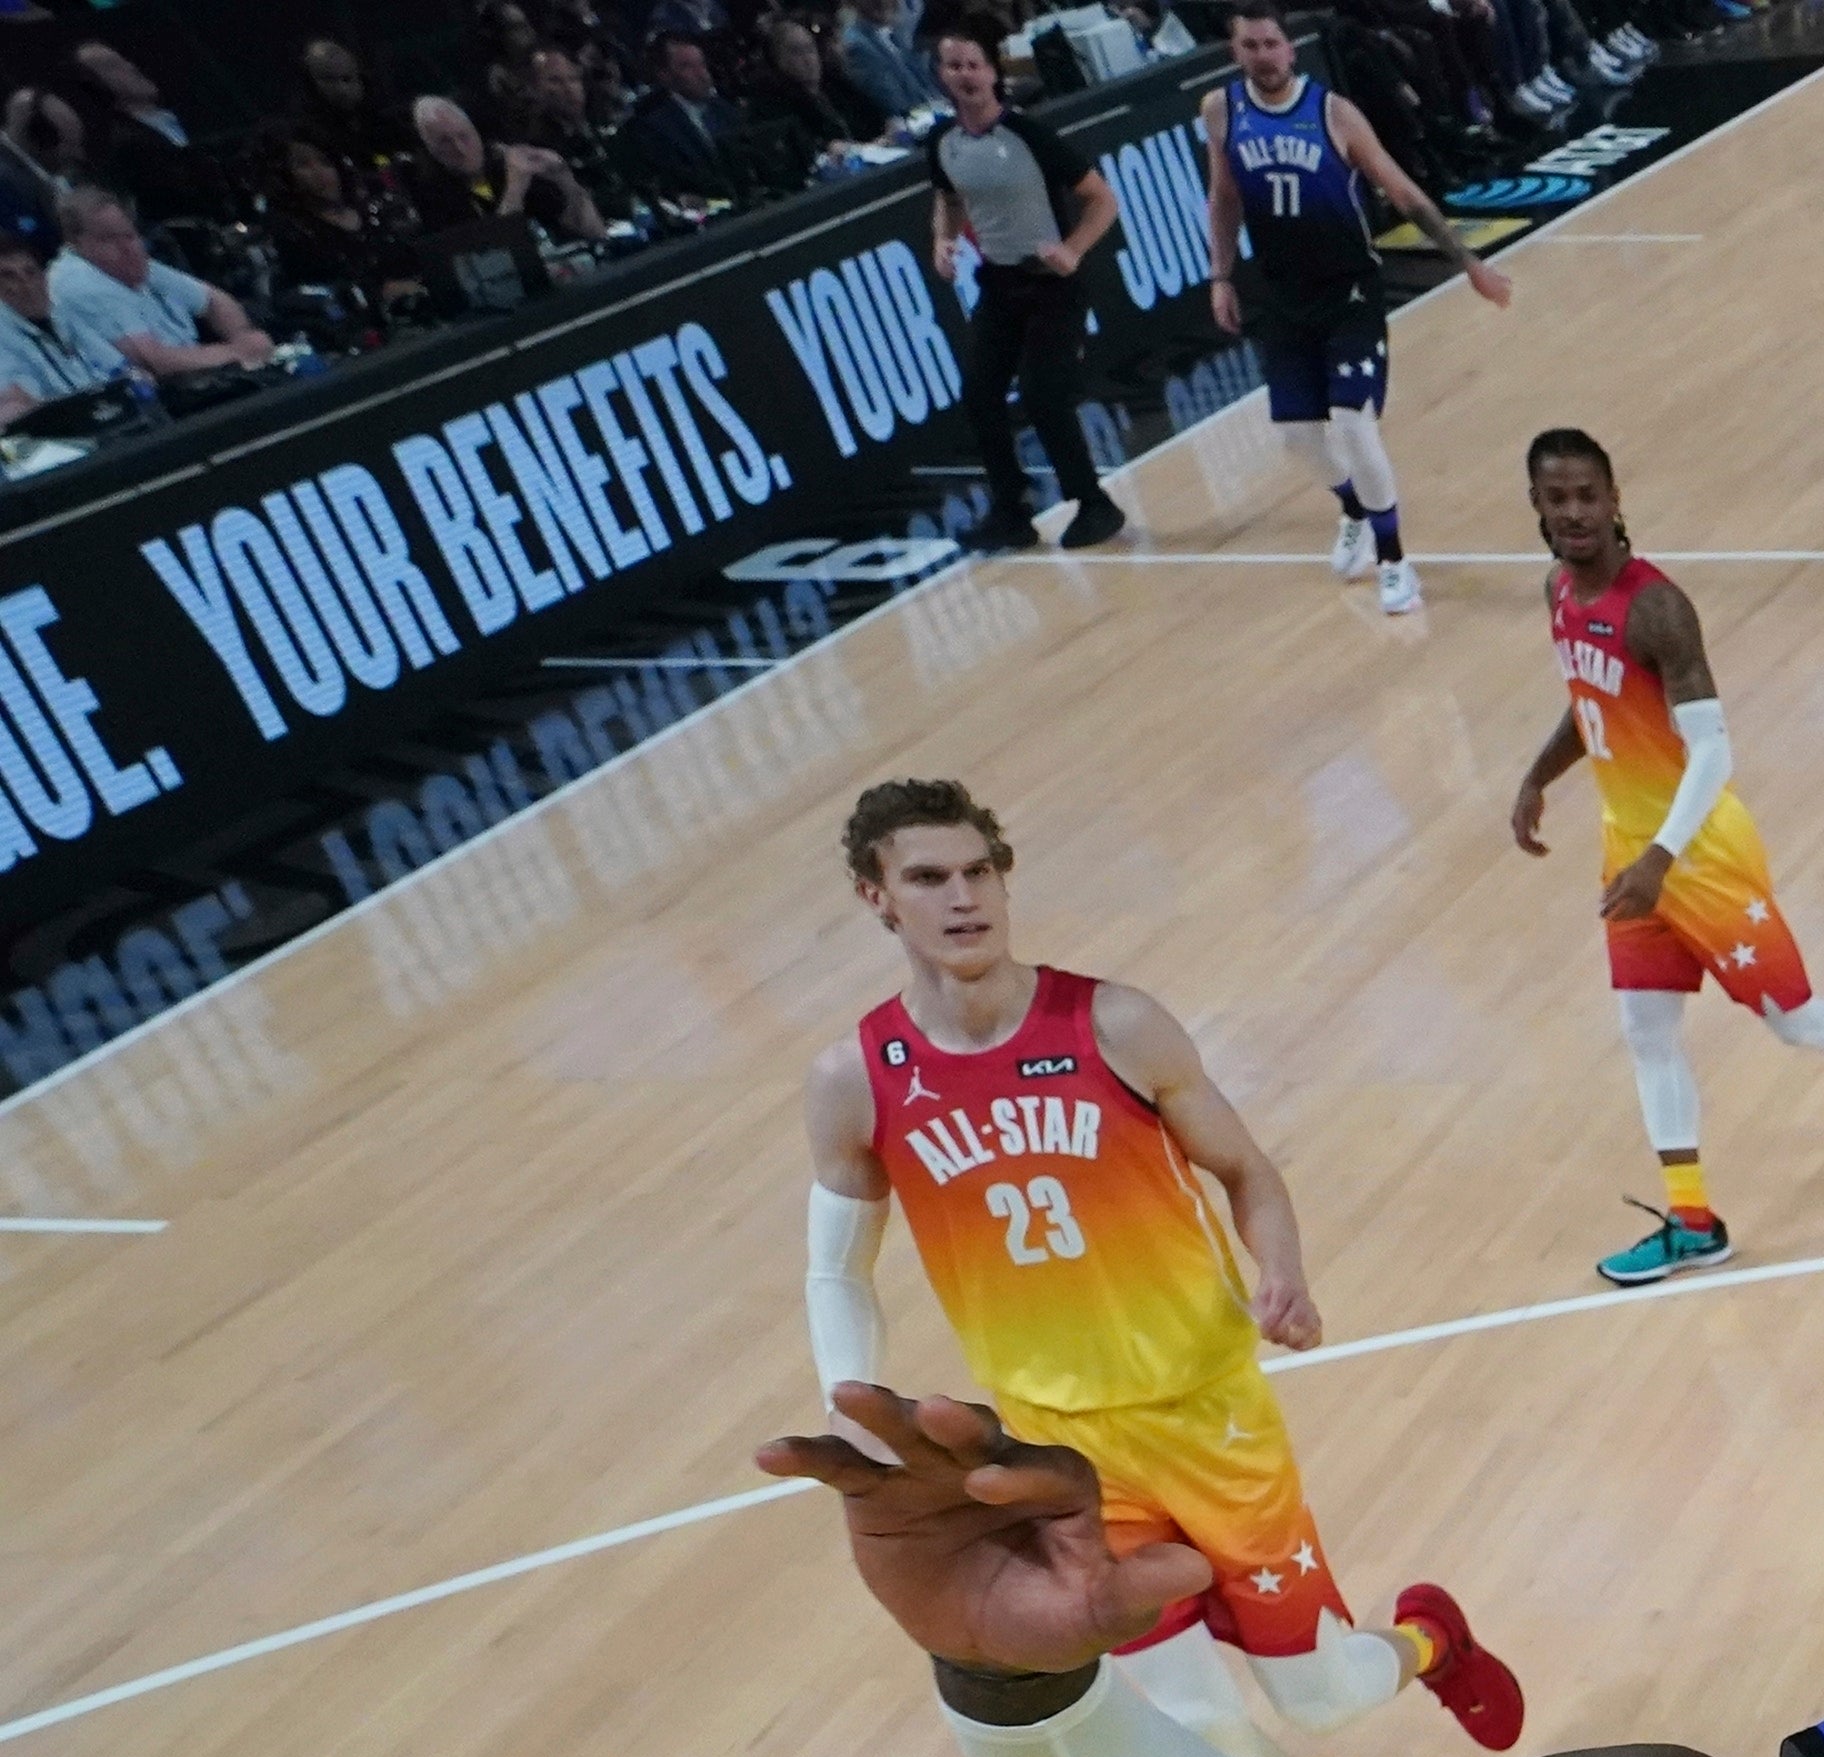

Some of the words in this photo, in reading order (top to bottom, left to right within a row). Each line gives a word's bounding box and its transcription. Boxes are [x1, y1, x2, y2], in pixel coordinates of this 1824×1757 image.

[1264, 172, 1300, 217] 77
[139, 463, 463, 741] YOUR
[391, 322, 793, 638] BENEFITS.
[764, 239, 961, 458] YOUR
[1100, 124, 1211, 311] JOIN
[886, 1040, 907, 1066] 6
[1022, 1058, 1076, 1077] KIA
[985, 1175, 1086, 1266] 23
